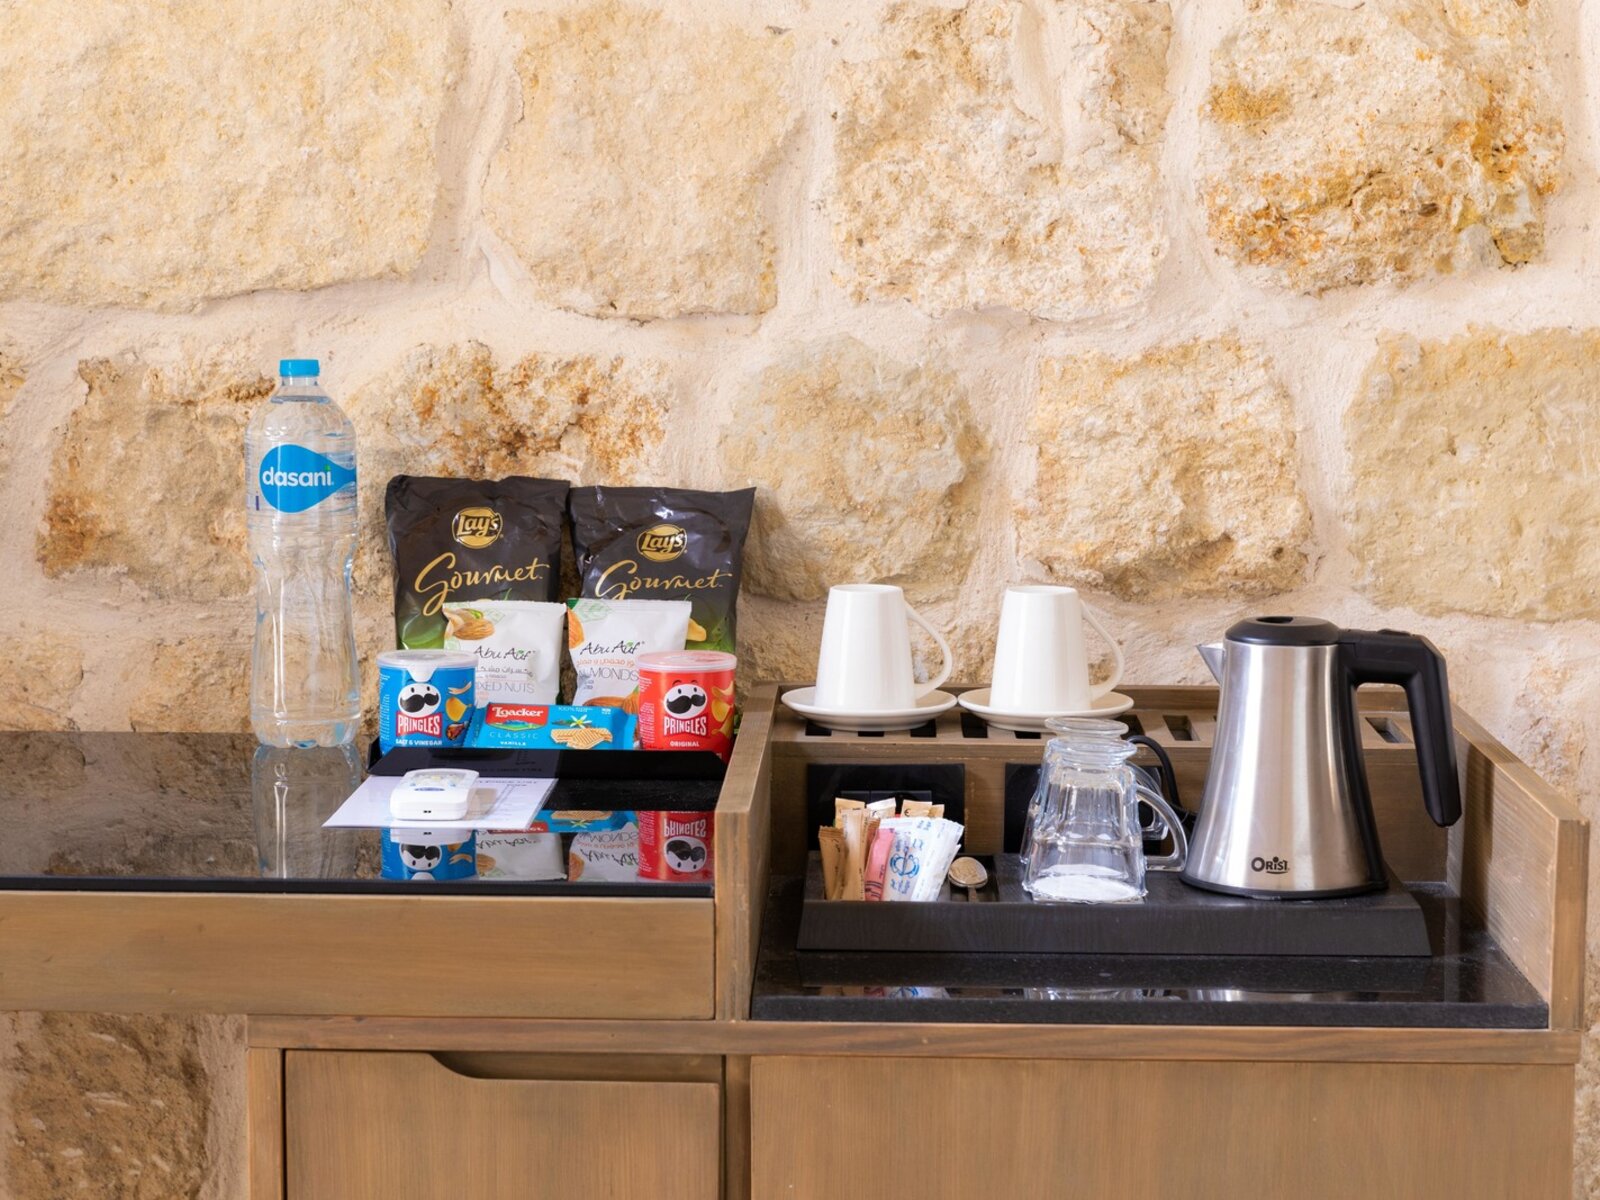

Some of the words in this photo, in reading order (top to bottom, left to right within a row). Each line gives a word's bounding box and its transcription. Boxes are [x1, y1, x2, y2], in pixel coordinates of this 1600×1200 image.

[262, 464, 332, 487] dasani
[414, 552, 550, 616] Gourmet
[595, 560, 733, 600] Gourmet
[474, 645, 502, 659] Abu
[579, 642, 610, 655] Abu
[504, 682, 535, 694] NUTS
[491, 706, 544, 718] Loacker
[397, 714, 441, 736] PRINGLES
[663, 715, 707, 736] PRINGLES
